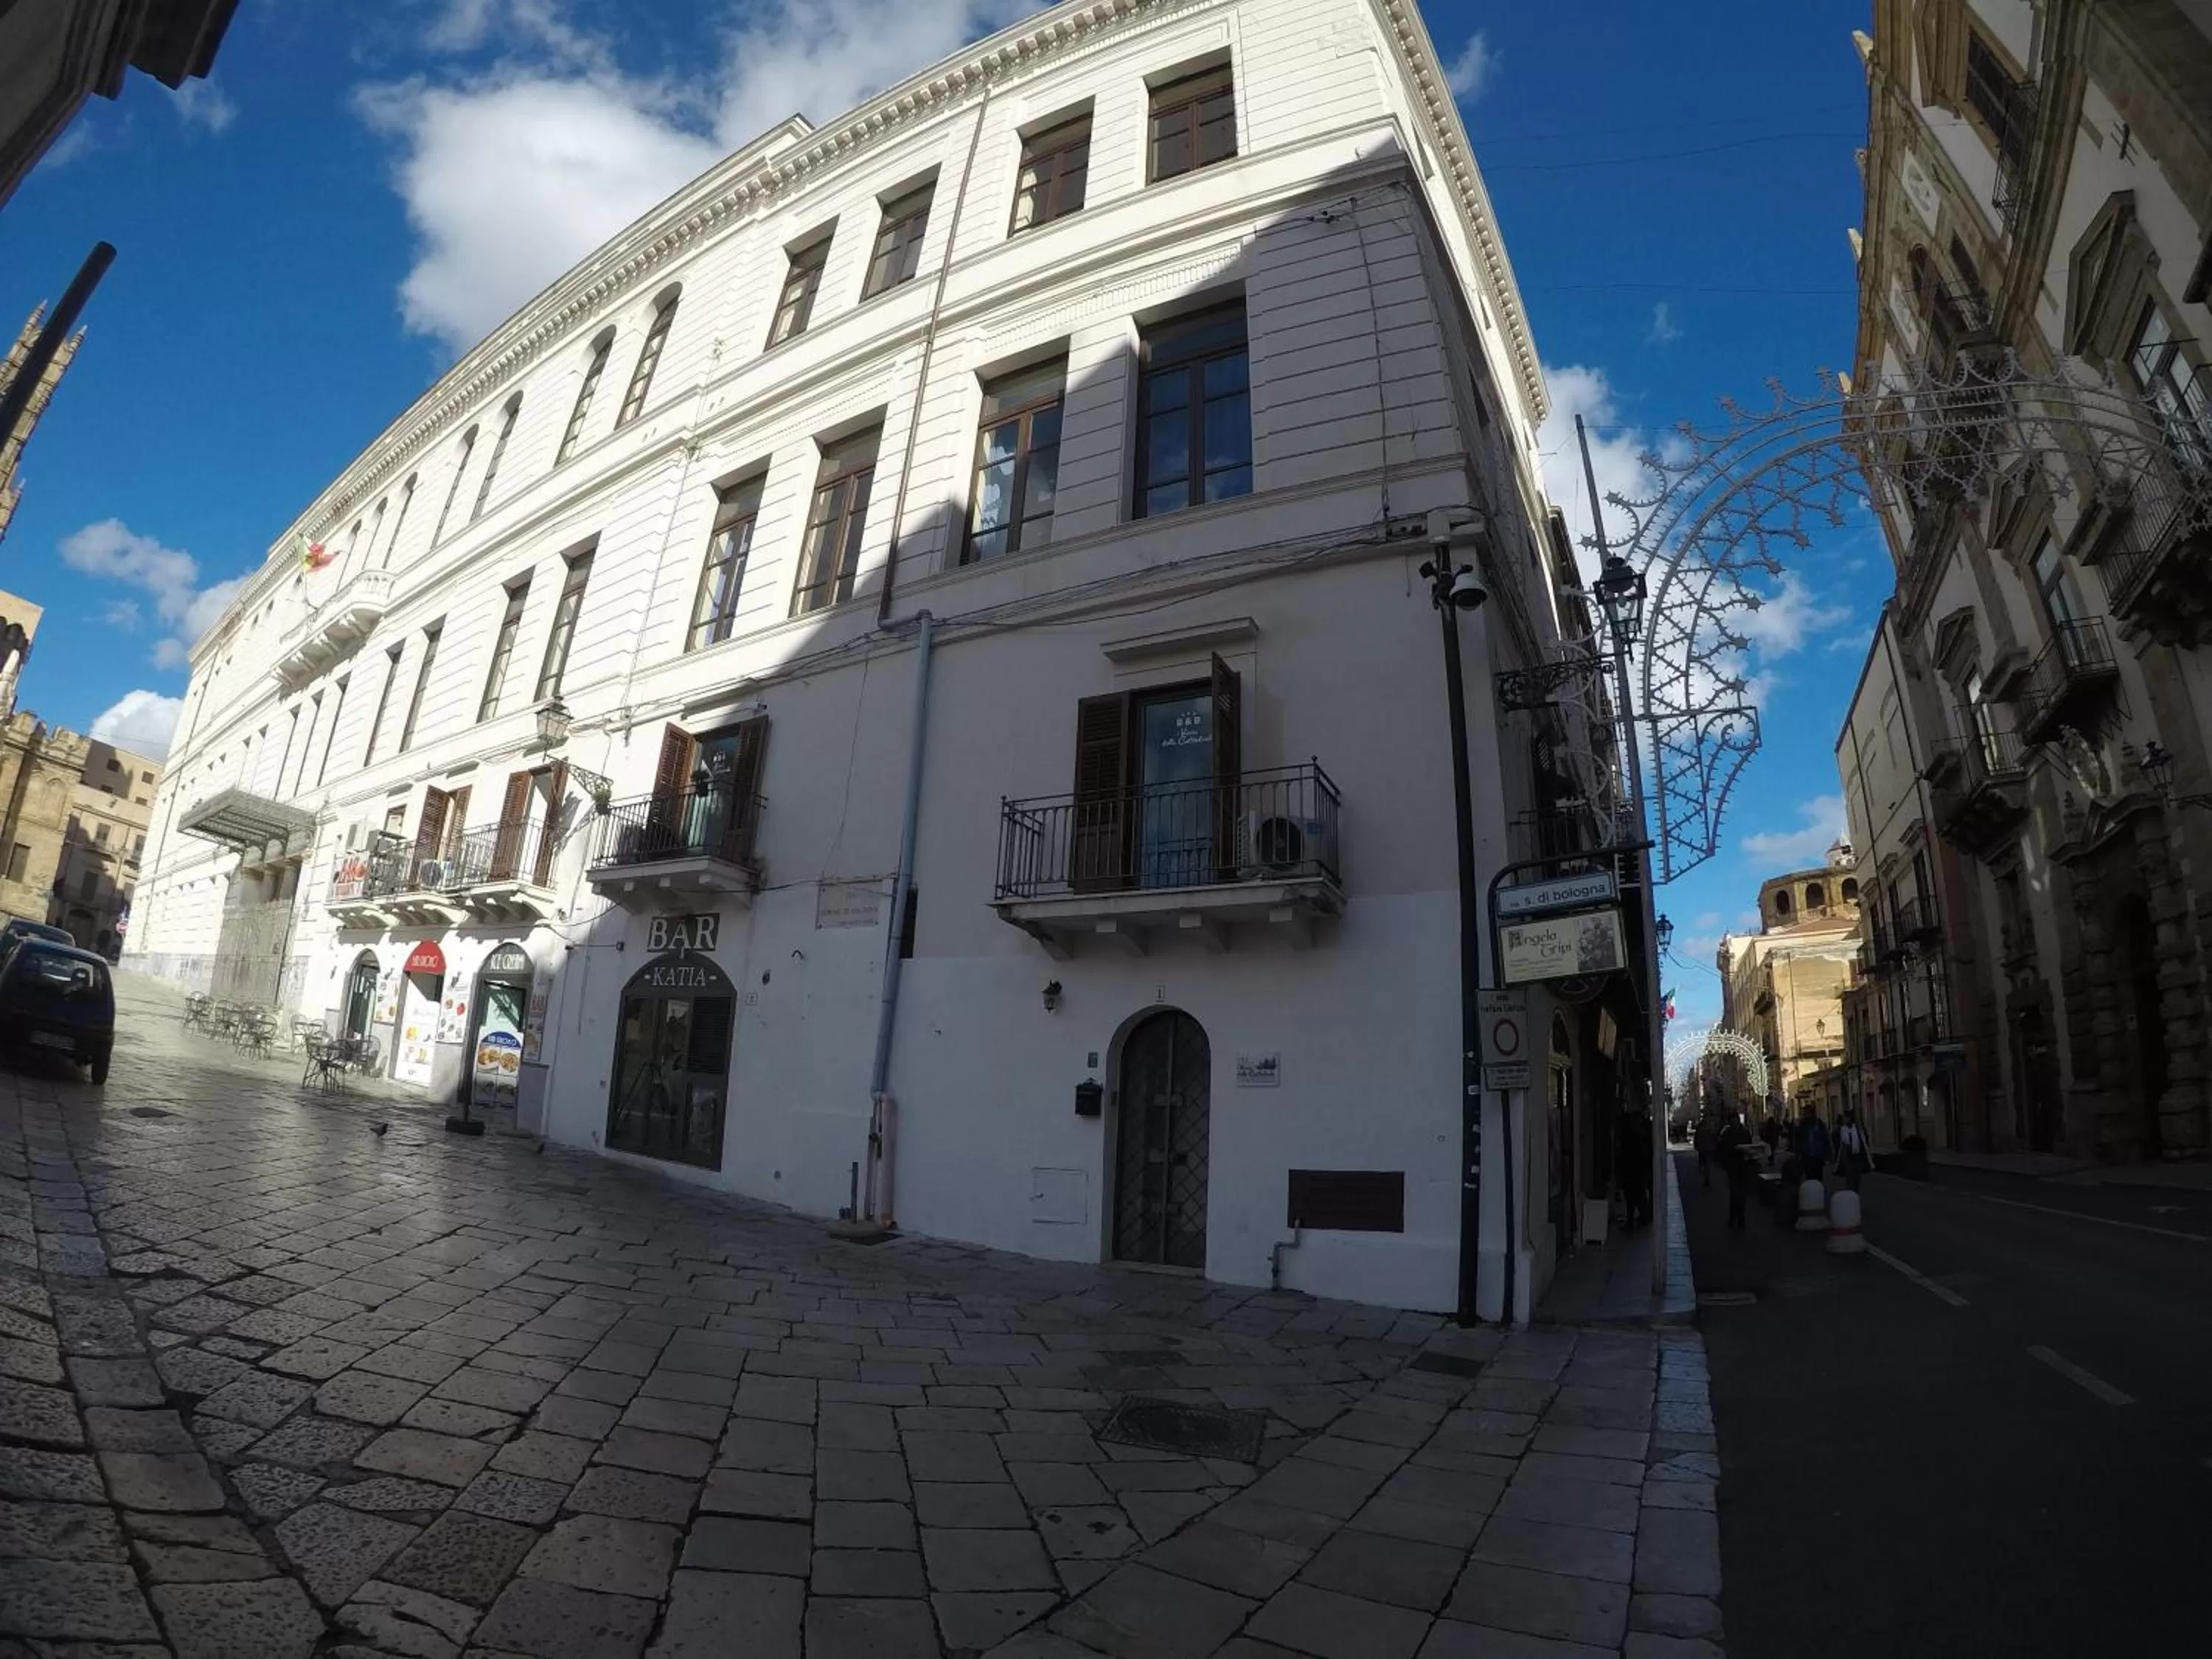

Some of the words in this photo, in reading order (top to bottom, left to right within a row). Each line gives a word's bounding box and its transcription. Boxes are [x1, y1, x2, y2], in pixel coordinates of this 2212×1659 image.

[1537, 890, 1550, 903] di
[1553, 883, 1606, 901] bologna
[647, 916, 716, 951] BAR
[651, 967, 708, 987] KATIA
